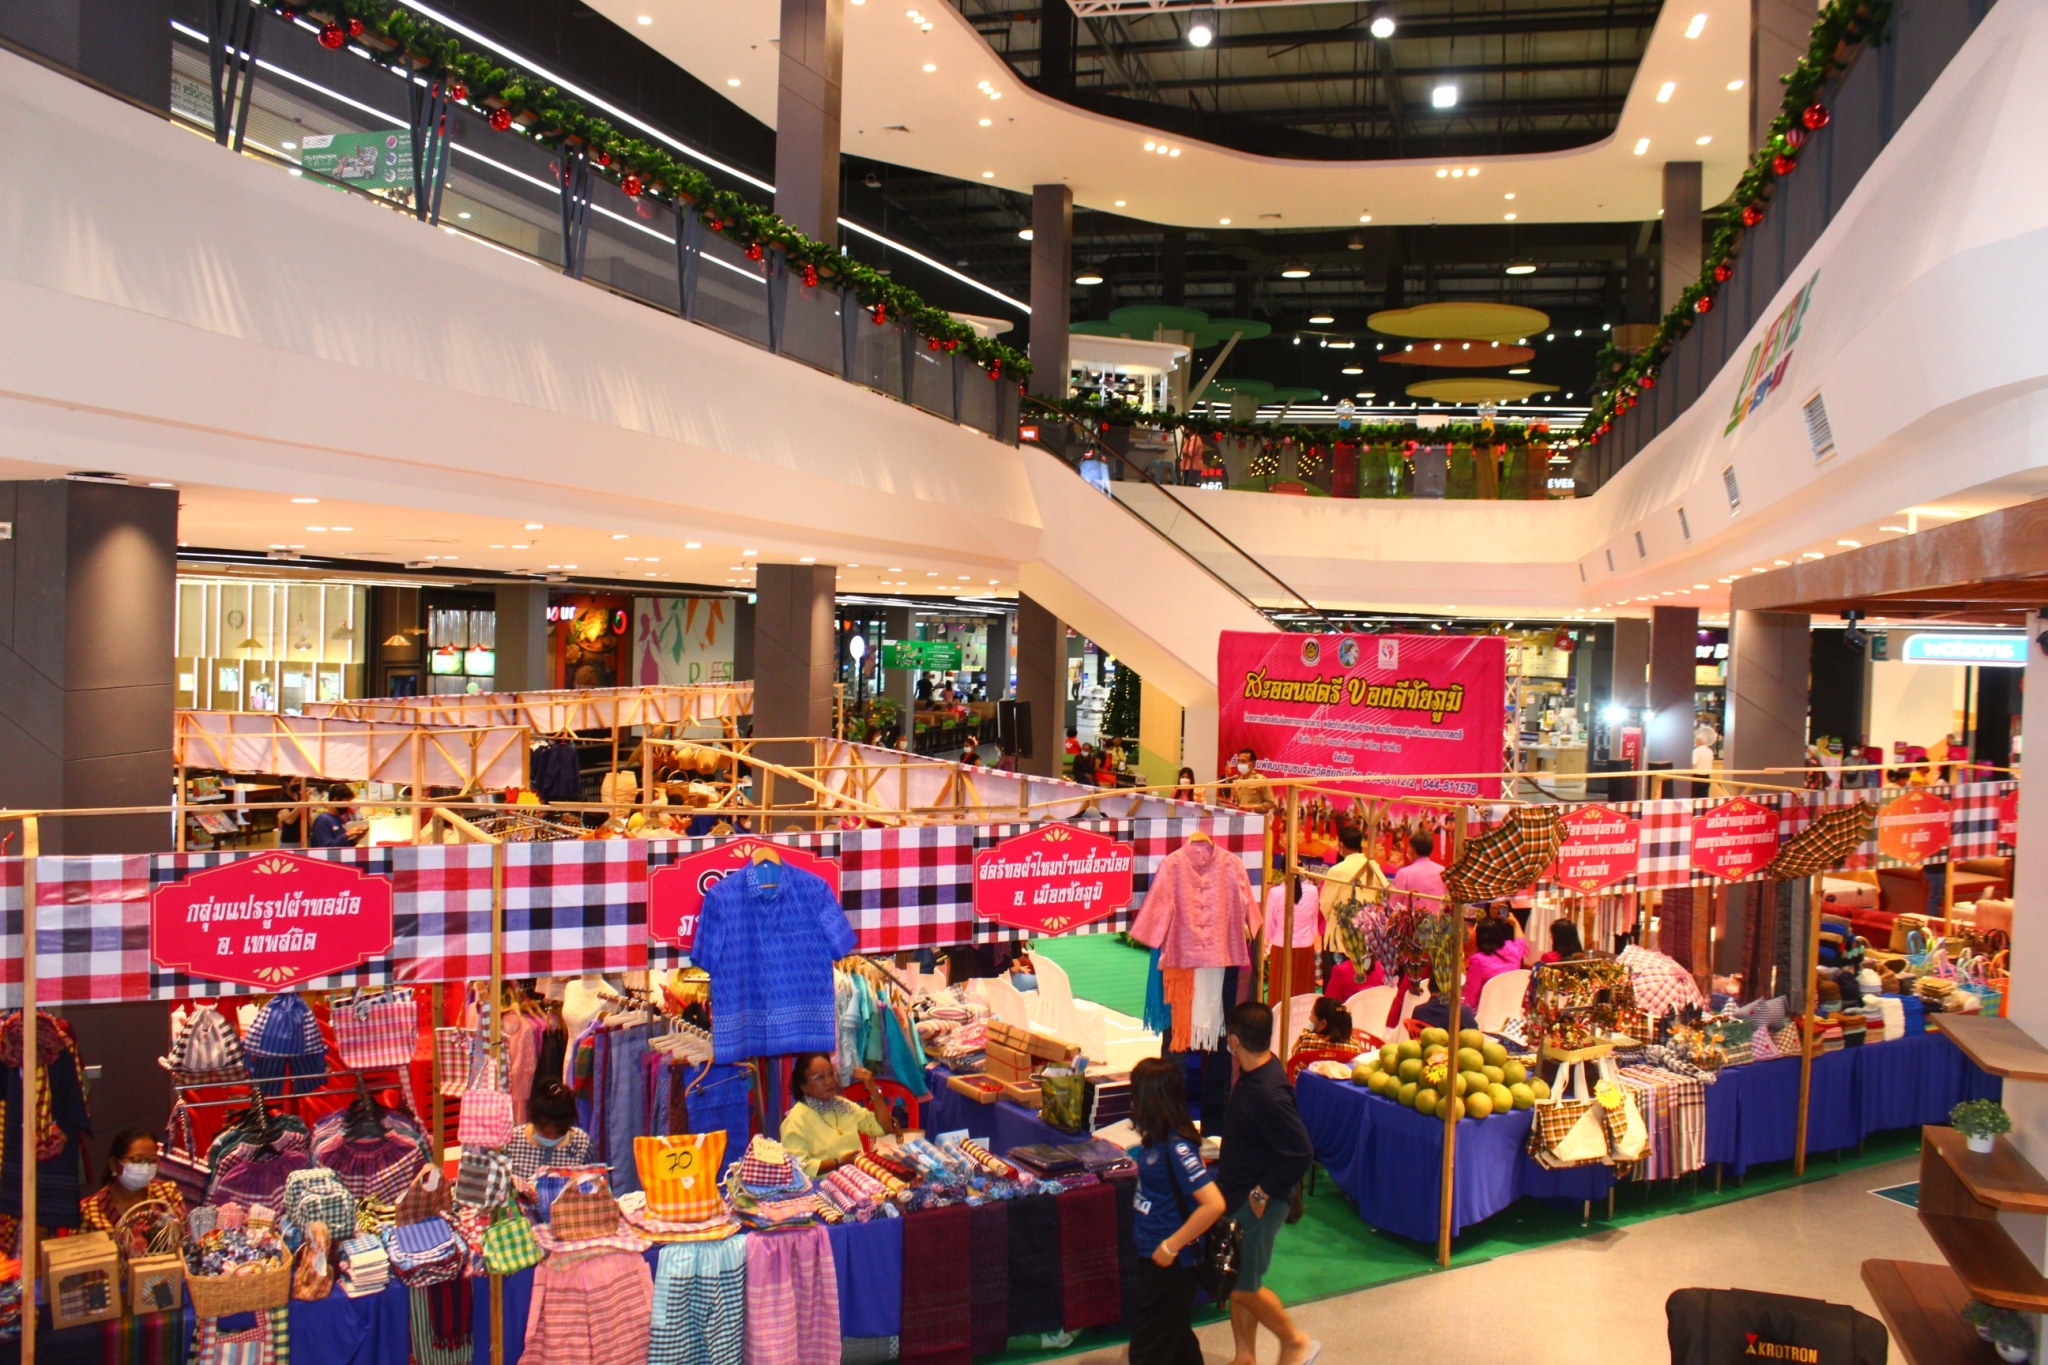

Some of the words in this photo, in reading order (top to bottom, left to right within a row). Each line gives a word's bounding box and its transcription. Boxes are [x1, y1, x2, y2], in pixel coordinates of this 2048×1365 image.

[1333, 751, 1354, 764] จัดโดย
[1422, 778, 1478, 794] 044-811578
[979, 847, 1130, 881] สตรีทอผ้าไหมบ้านเสี้ยวน้อย
[1013, 890, 1027, 907] อ.
[1033, 881, 1103, 909] เมืองชัยภูมิ
[186, 890, 361, 932] กลุ่มแปรรูปผ้าทอมือ
[216, 936, 234, 955] อ.
[243, 927, 317, 954] เทพสถิต
[666, 1150, 693, 1174] 70
[1758, 1341, 1819, 1364] KROTRON
